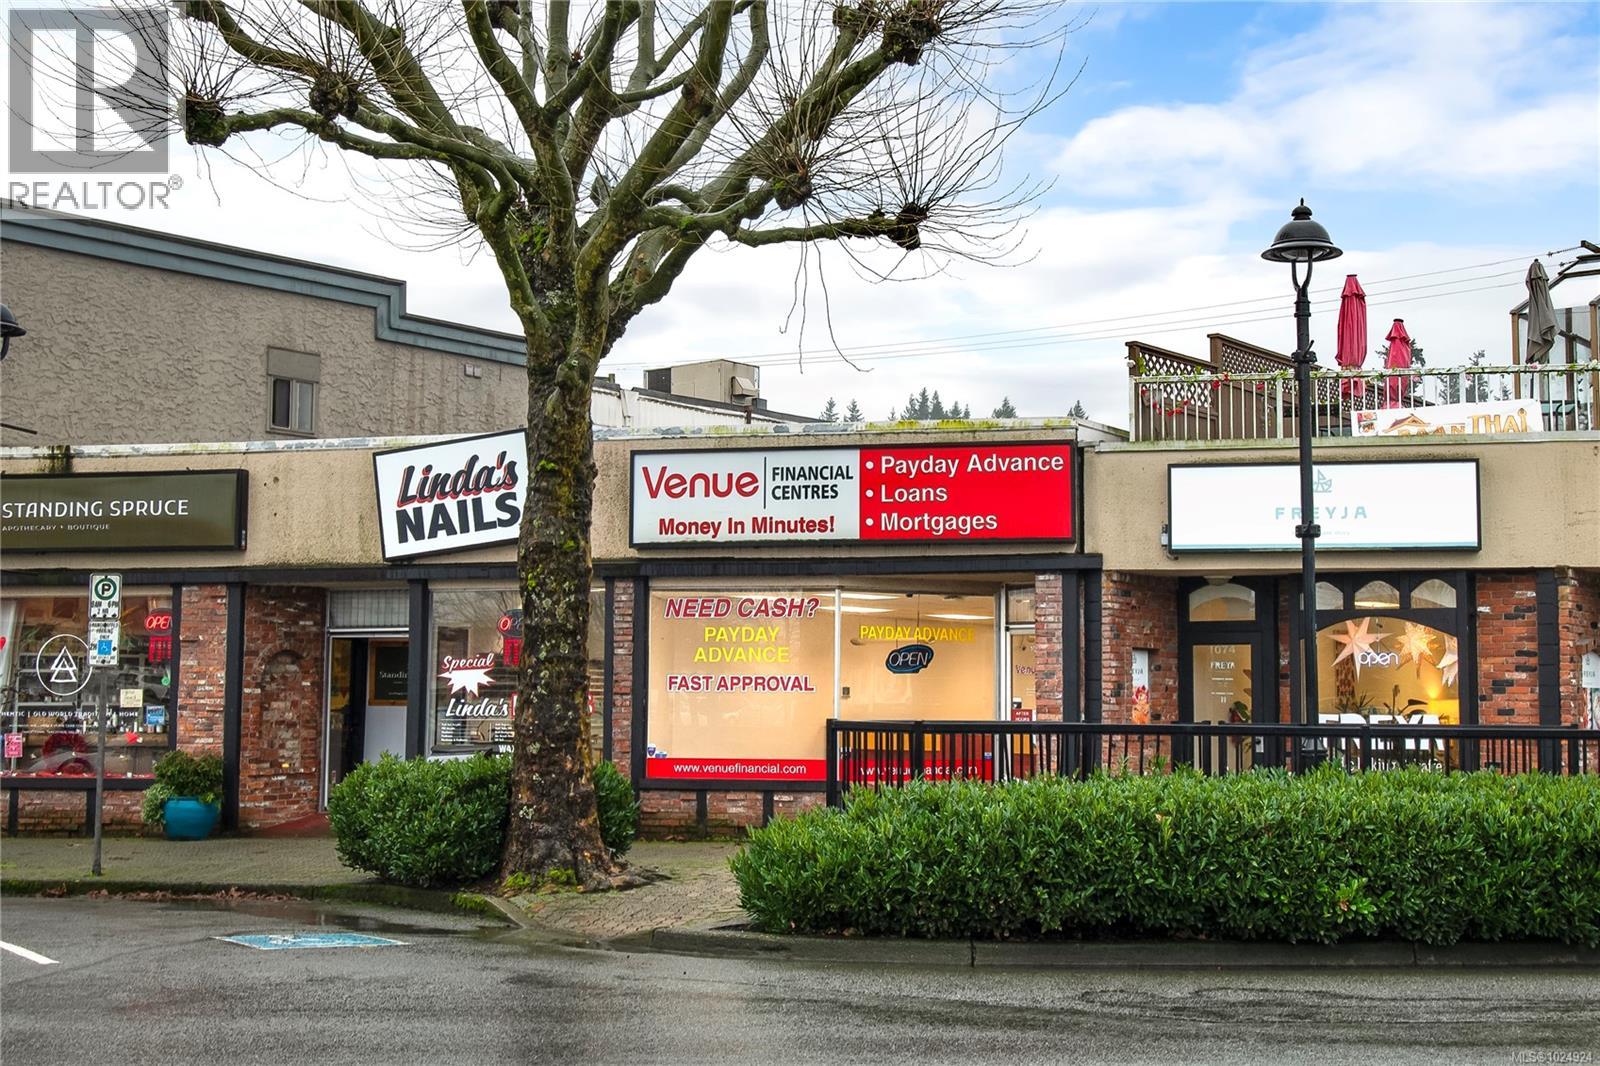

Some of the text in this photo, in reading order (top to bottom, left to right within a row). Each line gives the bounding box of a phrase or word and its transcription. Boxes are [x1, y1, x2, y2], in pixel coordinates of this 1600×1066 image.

[772, 466, 853, 482] FINANCIAL
[880, 454, 1064, 478] Payday Advance
[397, 451, 518, 508] Linda's
[642, 466, 760, 499] Venue
[772, 484, 839, 501] CENTRES
[880, 484, 948, 503] Loans
[2, 499, 189, 518] STANDING SPRUCE
[1274, 506, 1367, 520] FREYJA
[396, 492, 521, 544] NAILS
[880, 513, 998, 535] Mortgages
[67, 523, 110, 531] BOUTIQUE
[659, 516, 835, 539] Money In Minutes!
[665, 597, 820, 618] NEED CASH?
[146, 616, 173, 629] OPE
[704, 626, 780, 643] PAYDAY
[860, 626, 976, 642] PAYDAY ADVANCE
[694, 647, 790, 663] ADVANCE
[889, 652, 928, 666] OPEN
[1210, 646, 1235, 655] 1074
[443, 653, 495, 673] Special
[1359, 652, 1399, 667] open
[667, 675, 815, 692] FAST APPROVAL
[446, 698, 508, 717] Linda's
[673, 763, 807, 774] www.venuefinancial.com
